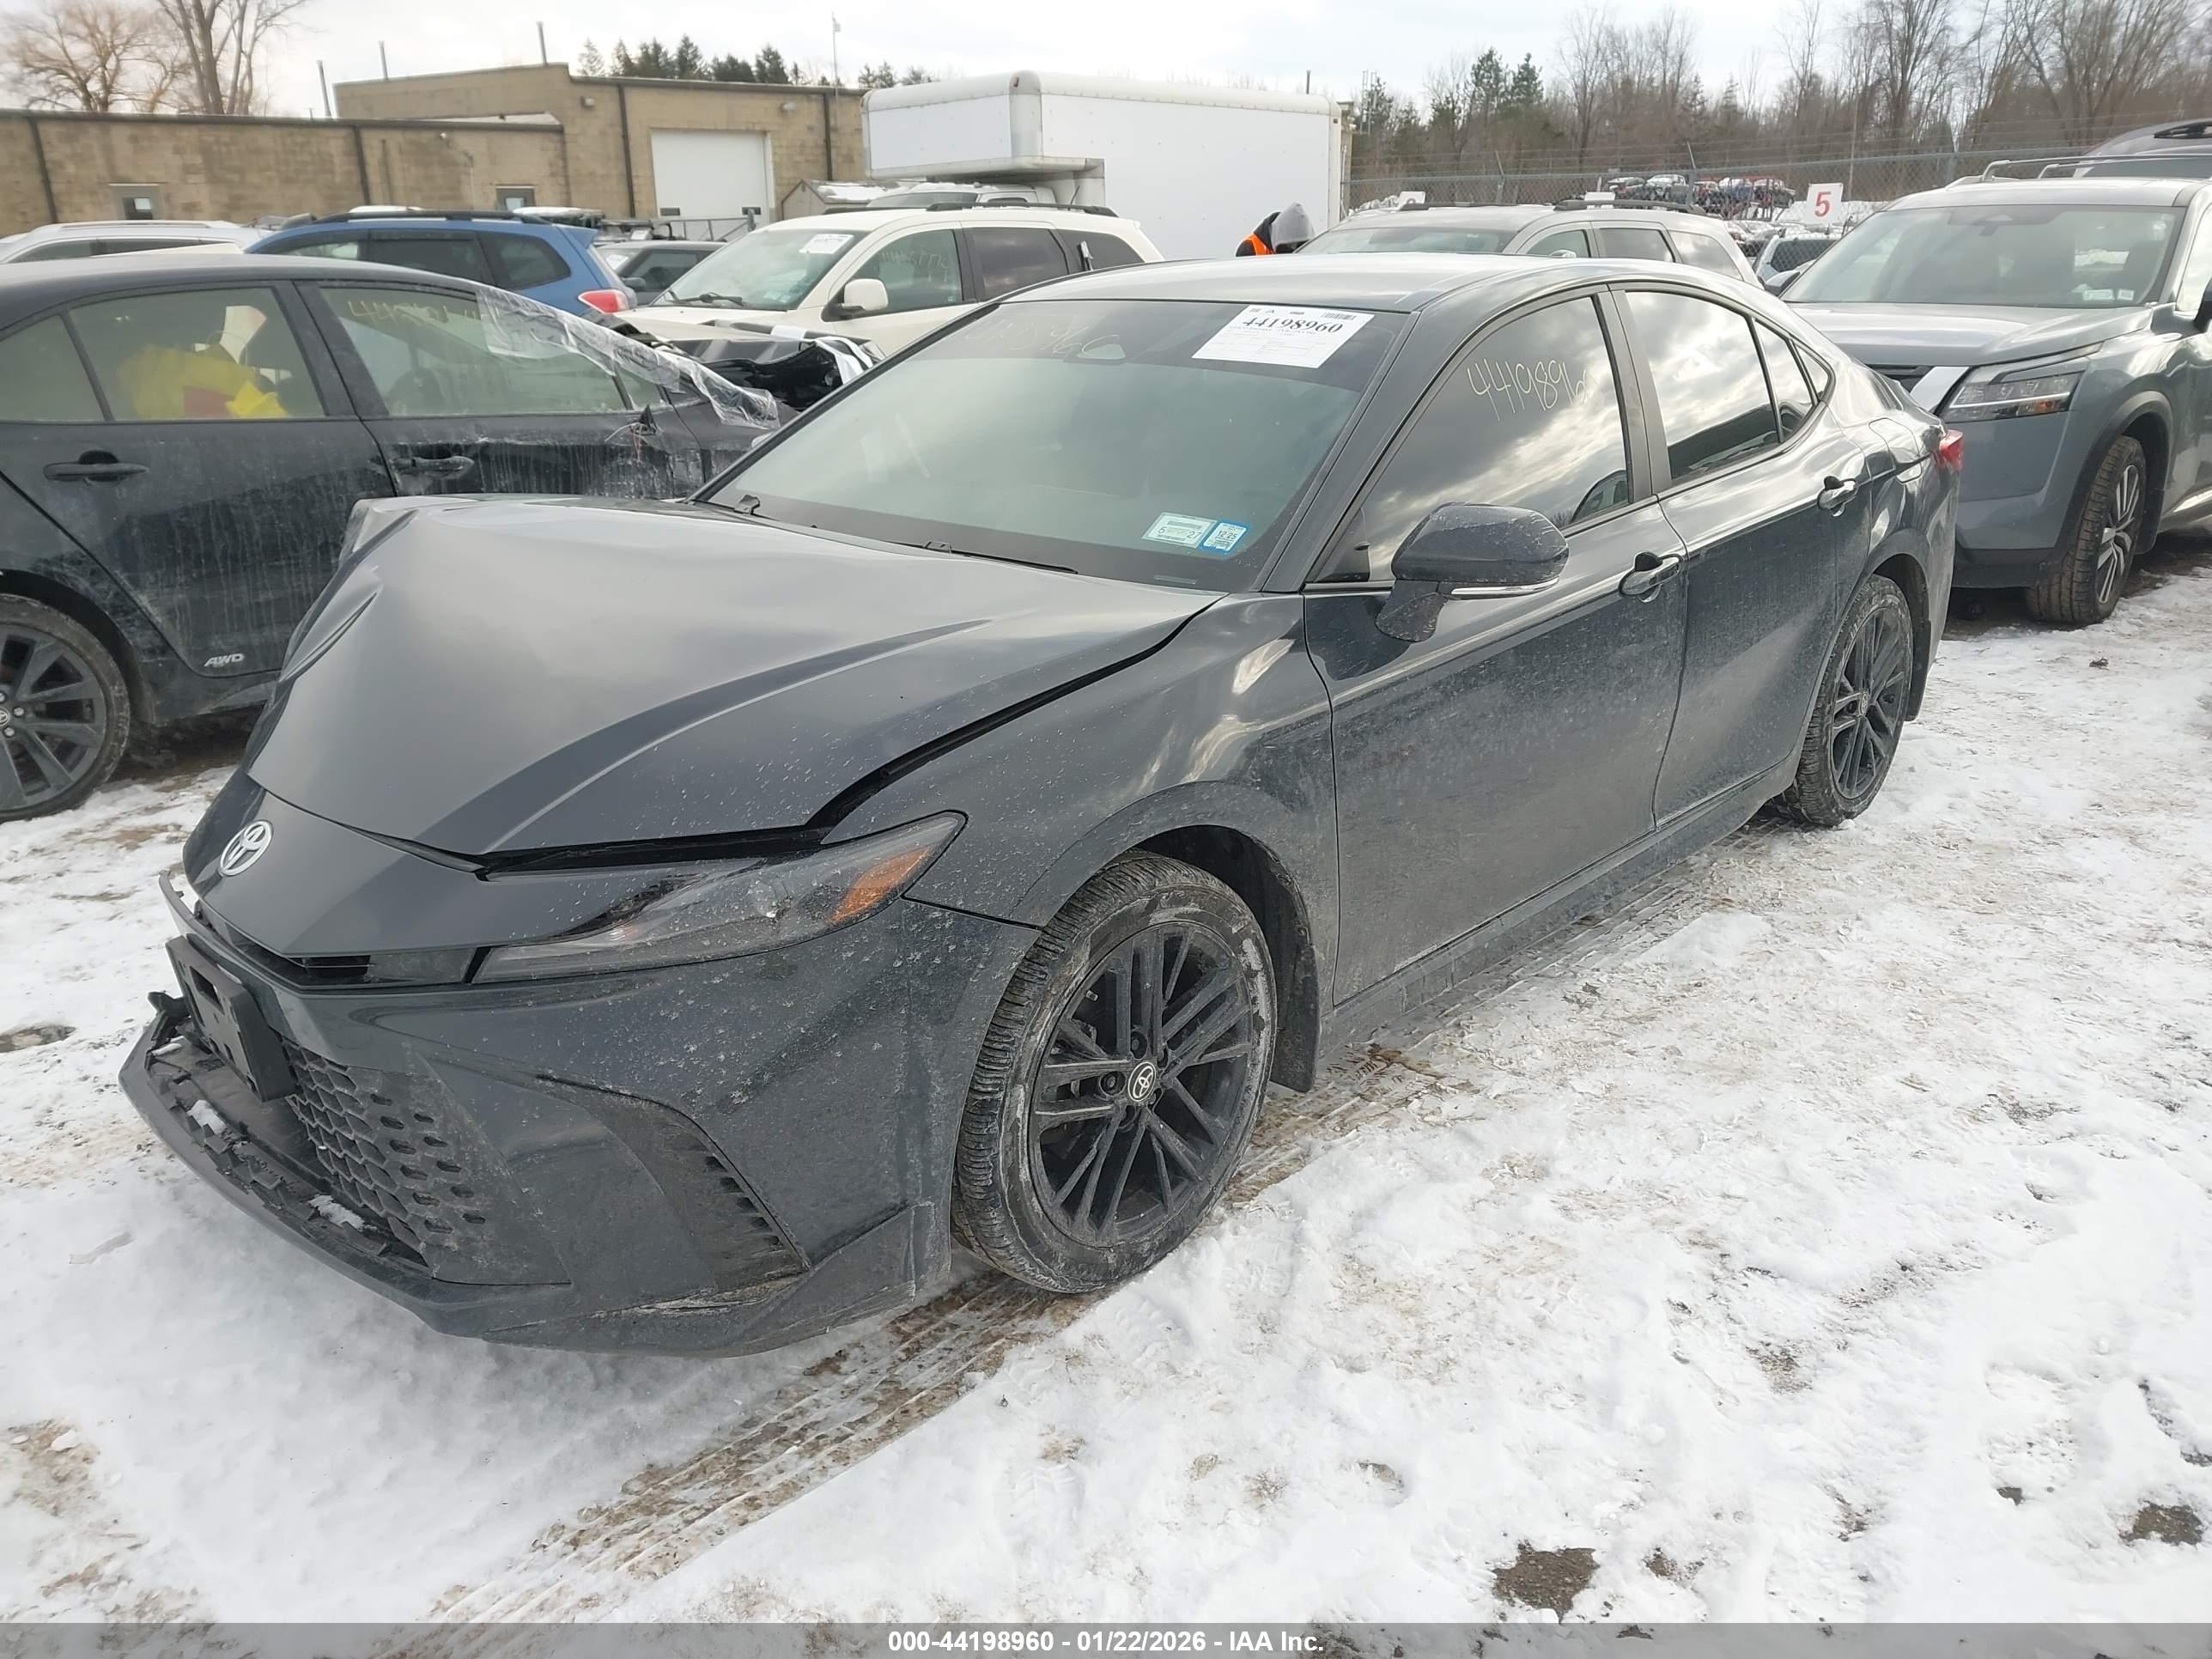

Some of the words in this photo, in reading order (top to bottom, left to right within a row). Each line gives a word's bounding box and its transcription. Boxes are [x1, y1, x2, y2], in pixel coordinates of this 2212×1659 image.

[1814, 191, 1831, 216] 5
[1243, 317, 1343, 333] 44198960
[204, 653, 245, 667] AWD
